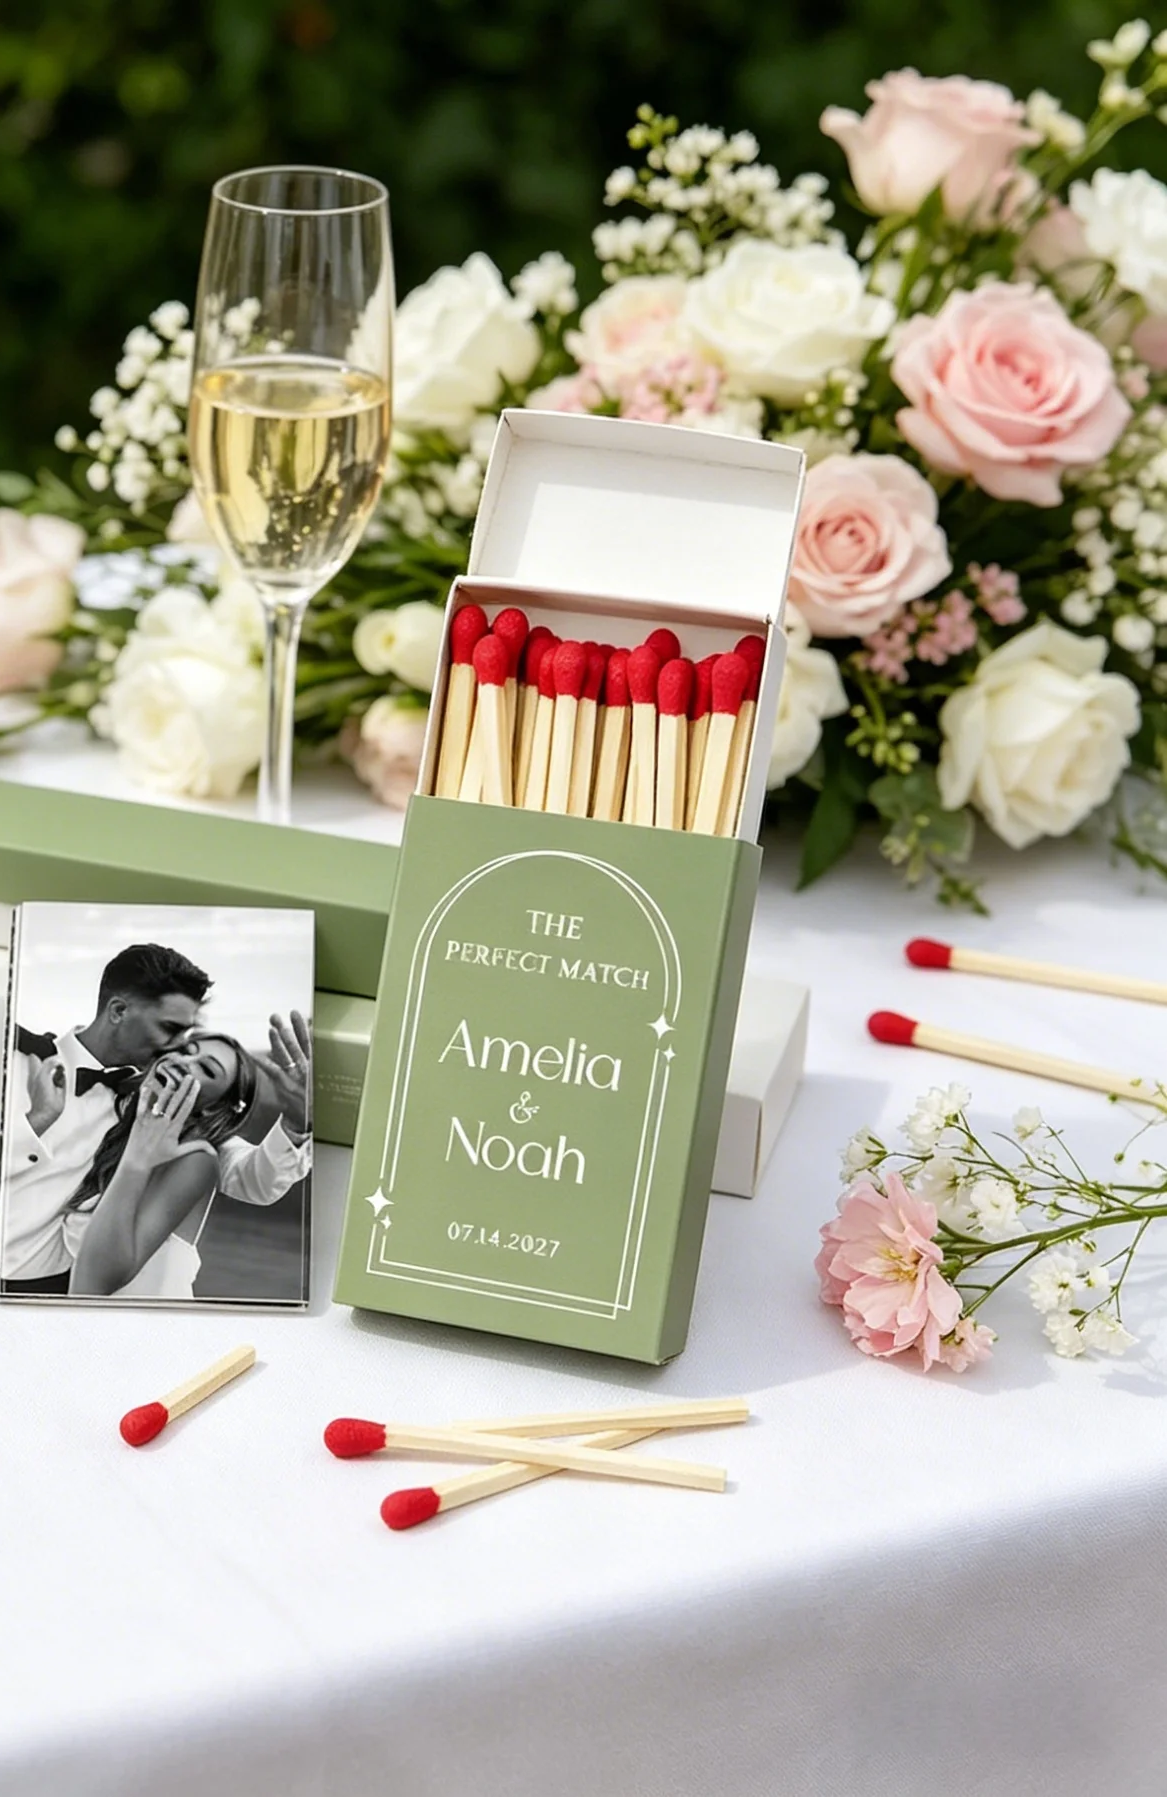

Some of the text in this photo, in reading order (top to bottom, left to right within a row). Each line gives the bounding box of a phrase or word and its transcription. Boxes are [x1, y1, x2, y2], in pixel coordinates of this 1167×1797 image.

[526, 909, 584, 940] THE
[444, 940, 650, 991] PERFECT MATCH
[438, 1019, 622, 1092] Amelia
[509, 1090, 540, 1124] &
[445, 1116, 586, 1185] Noah
[447, 1221, 561, 1258] 07.14.2027
